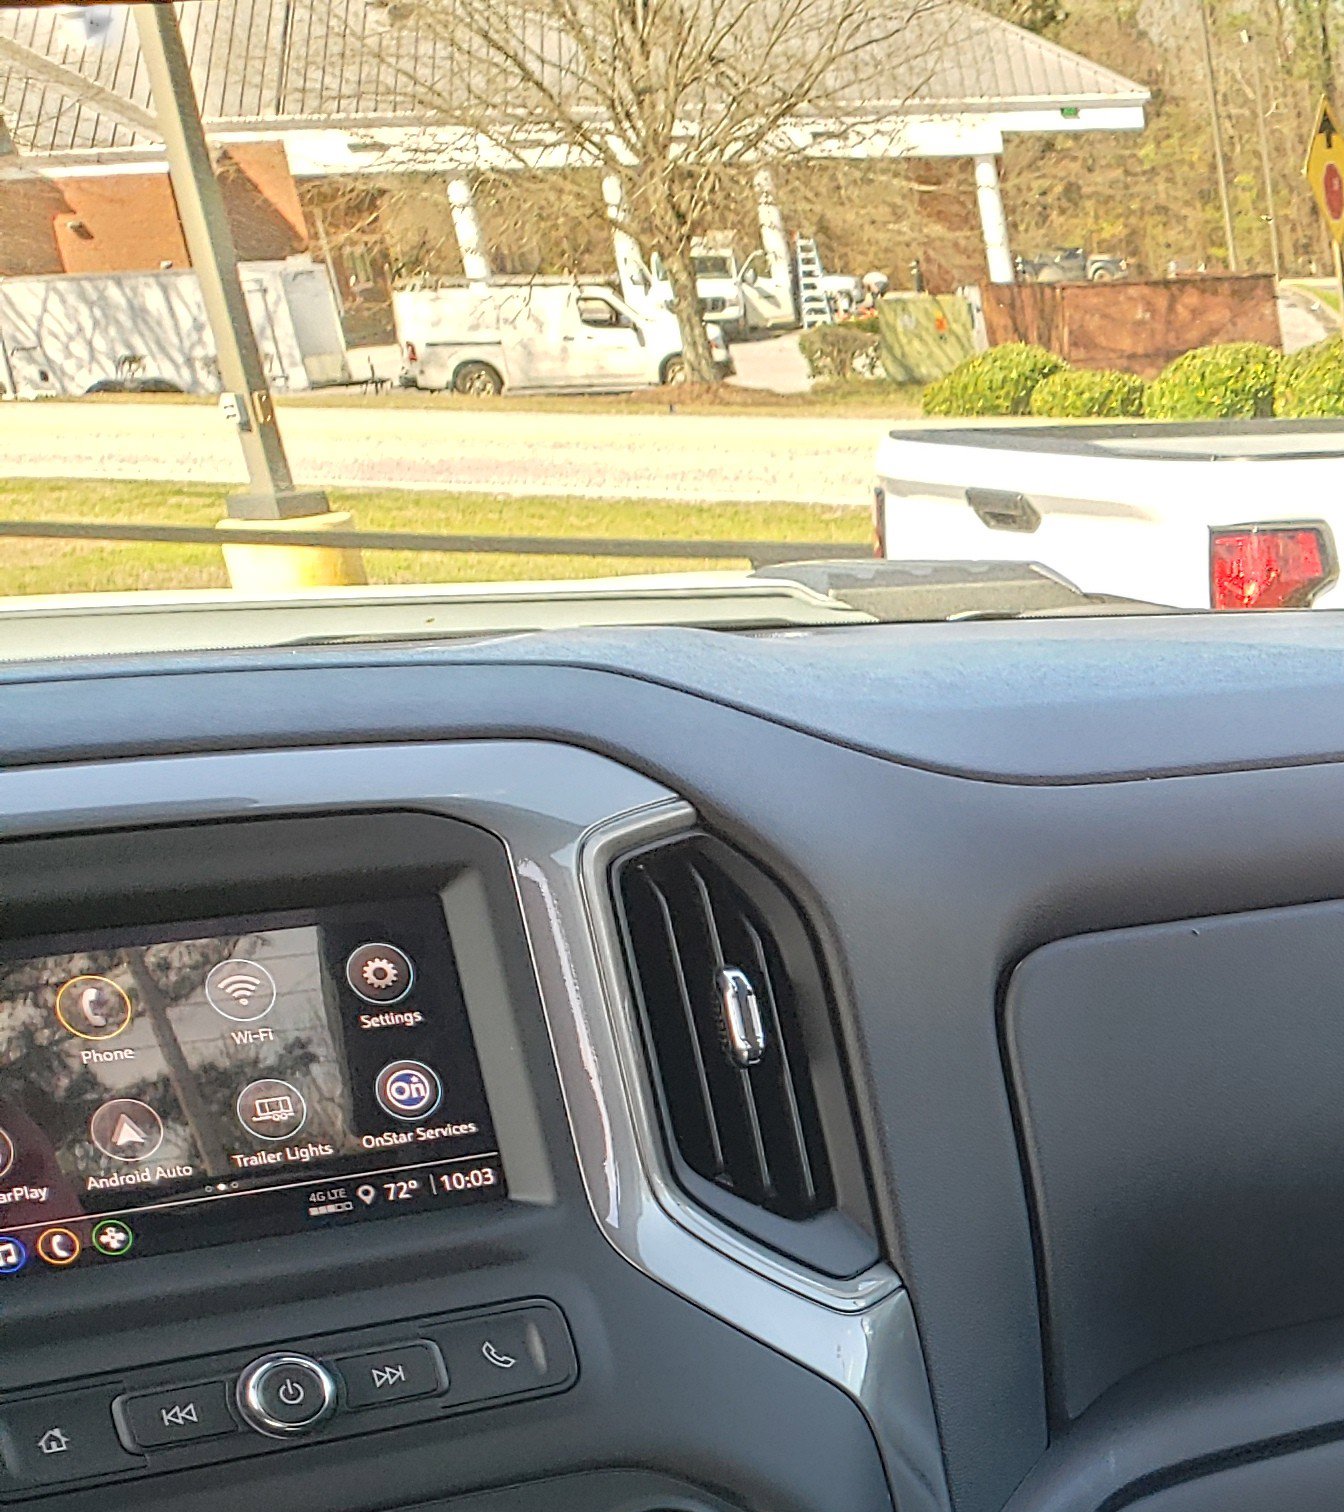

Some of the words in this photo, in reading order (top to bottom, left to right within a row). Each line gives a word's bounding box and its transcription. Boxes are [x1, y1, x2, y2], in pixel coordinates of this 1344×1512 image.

[359, 1010, 423, 1029] Settings
[231, 1028, 275, 1046] Wi-Fi
[80, 1047, 135, 1064] Phone
[362, 1133, 415, 1150] OnStar
[416, 1123, 477, 1142] Services
[231, 1150, 283, 1168] Trailer
[286, 1142, 334, 1163] Lights
[86, 1170, 152, 1191] Android
[155, 1164, 193, 1180] Auto
[440, 1167, 495, 1192] 10:03
[308, 1190, 327, 1203] 4G
[326, 1187, 348, 1200] LTE
